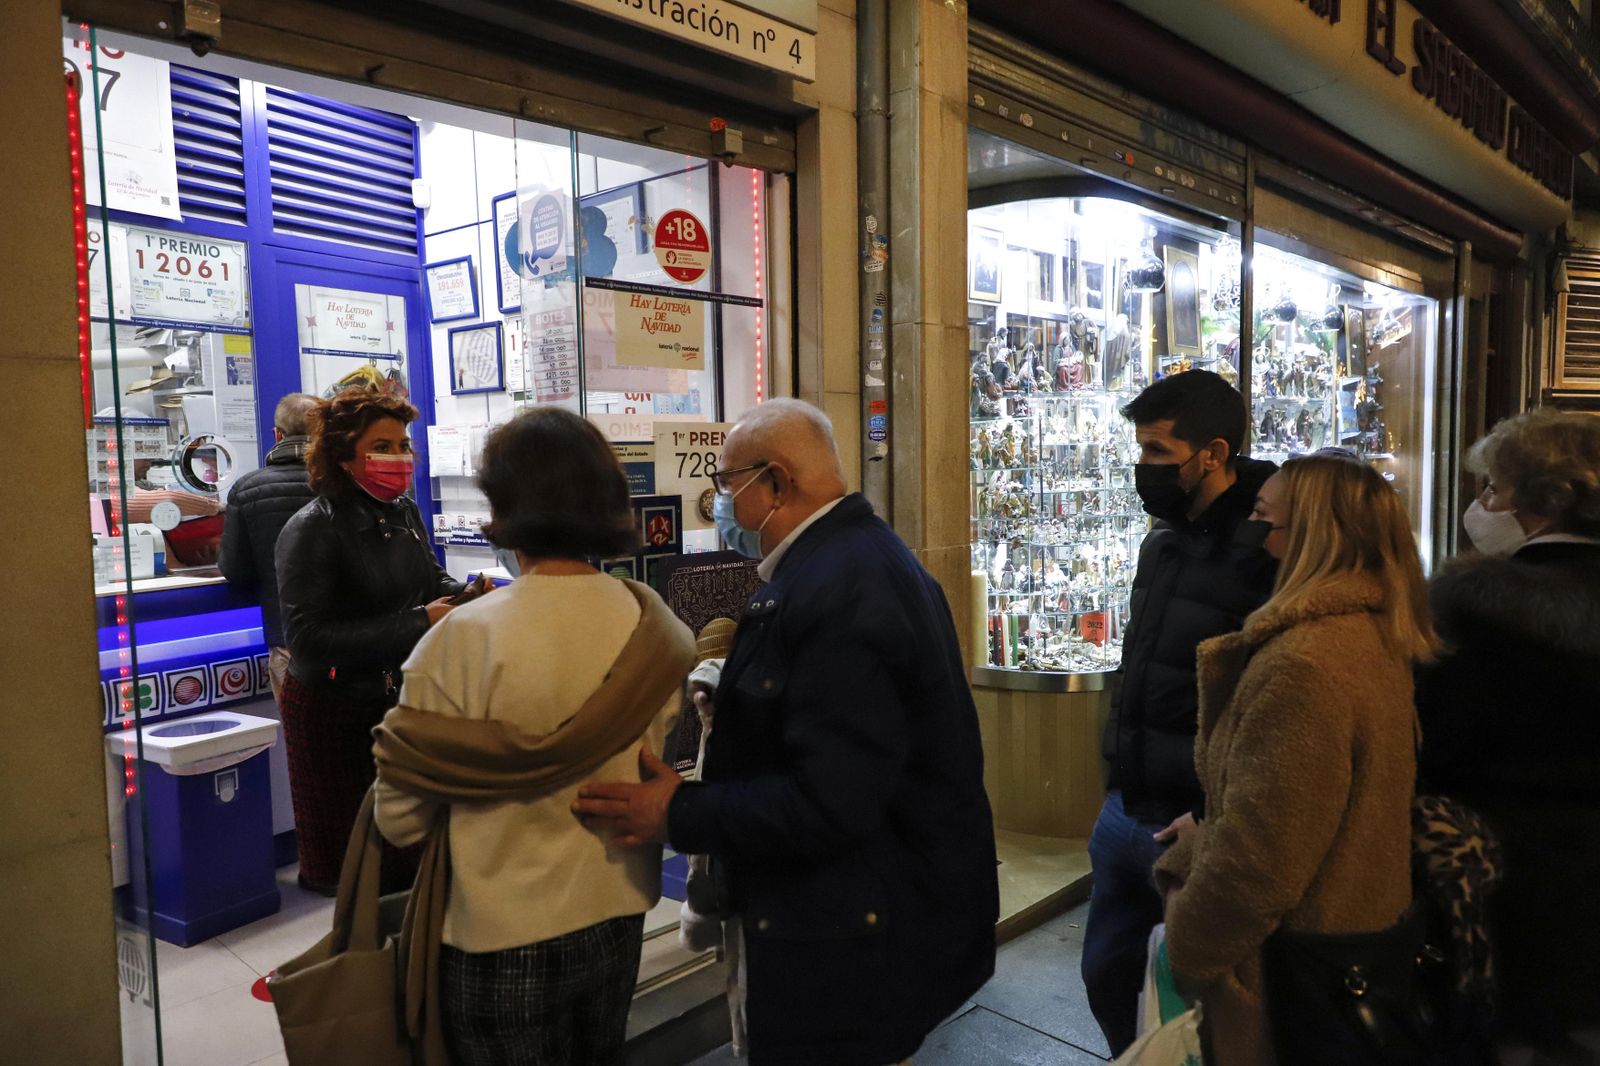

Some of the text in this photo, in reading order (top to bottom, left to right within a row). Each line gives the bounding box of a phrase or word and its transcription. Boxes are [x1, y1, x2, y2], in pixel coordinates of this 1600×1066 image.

[788, 39, 802, 64] 4
[665, 217, 697, 242] +18
[160, 237, 220, 258] PREMIO
[630, 294, 652, 308] HAY
[654, 312, 667, 321] DE
[640, 317, 682, 335] NAVIDAD
[672, 431, 685, 446] 1er
[675, 452, 722, 479] 728
[693, 564, 715, 572] LOTERÍA
[722, 561, 744, 569] NAVIDAD
